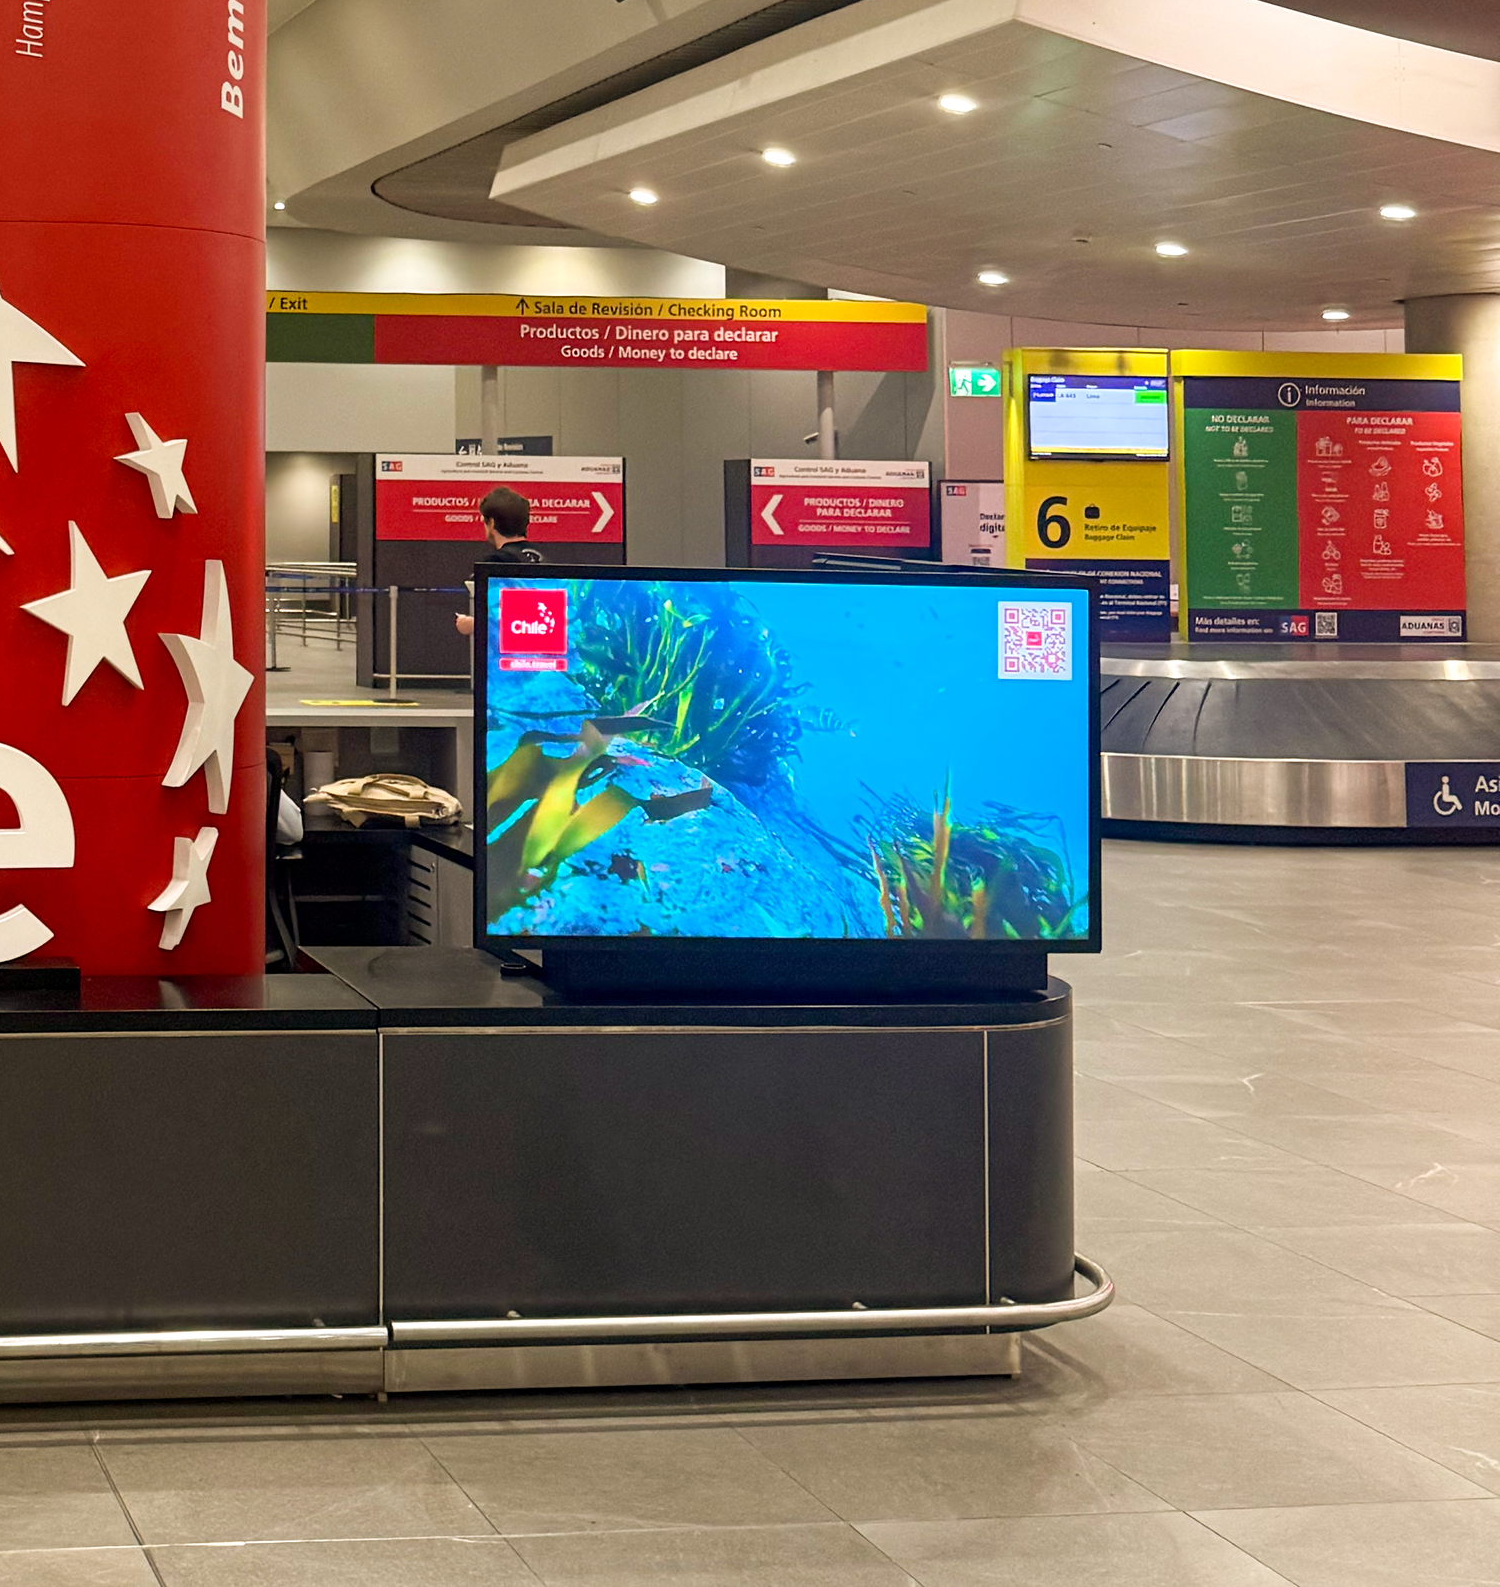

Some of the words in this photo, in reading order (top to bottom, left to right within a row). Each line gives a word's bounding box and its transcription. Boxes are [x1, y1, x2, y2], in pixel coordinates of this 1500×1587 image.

[280, 297, 308, 310] Exit
[534, 301, 565, 315] Sala
[569, 302, 587, 315] de
[592, 302, 653, 316] Revisión
[657, 304, 664, 316] /
[668, 304, 735, 320] Checking
[740, 305, 782, 318] Room
[520, 324, 599, 339] Productos
[603, 325, 611, 340] /
[616, 326, 669, 341] Dinero
[674, 330, 710, 344] para
[714, 327, 779, 343] declarar
[561, 345, 605, 359] Goods
[609, 346, 615, 359] /
[618, 346, 666, 362] Money
[670, 348, 685, 360] to
[688, 347, 738, 361] declare
[1305, 384, 1366, 396] Información
[1305, 398, 1356, 407] Information
[1211, 414, 1225, 423] NO
[1226, 415, 1270, 423] DECLARAR
[1370, 417, 1414, 425] DECLARAR
[382, 462, 402, 471] SAG
[754, 467, 774, 477] SAG
[412, 497, 469, 506] PRODUCTOS
[542, 499, 590, 508] DECLARAR
[804, 498, 861, 507] PRODUCTOS
[869, 498, 904, 508] DINERO
[816, 508, 841, 517] PARA
[844, 509, 892, 518] DECLARAR
[1037, 495, 1071, 549] 6
[1084, 524, 1108, 532] Retiro
[1110, 524, 1120, 532] de
[511, 620, 547, 635] Chile
[1281, 621, 1307, 634] SAG
[1402, 622, 1444, 630] ADUANAS
